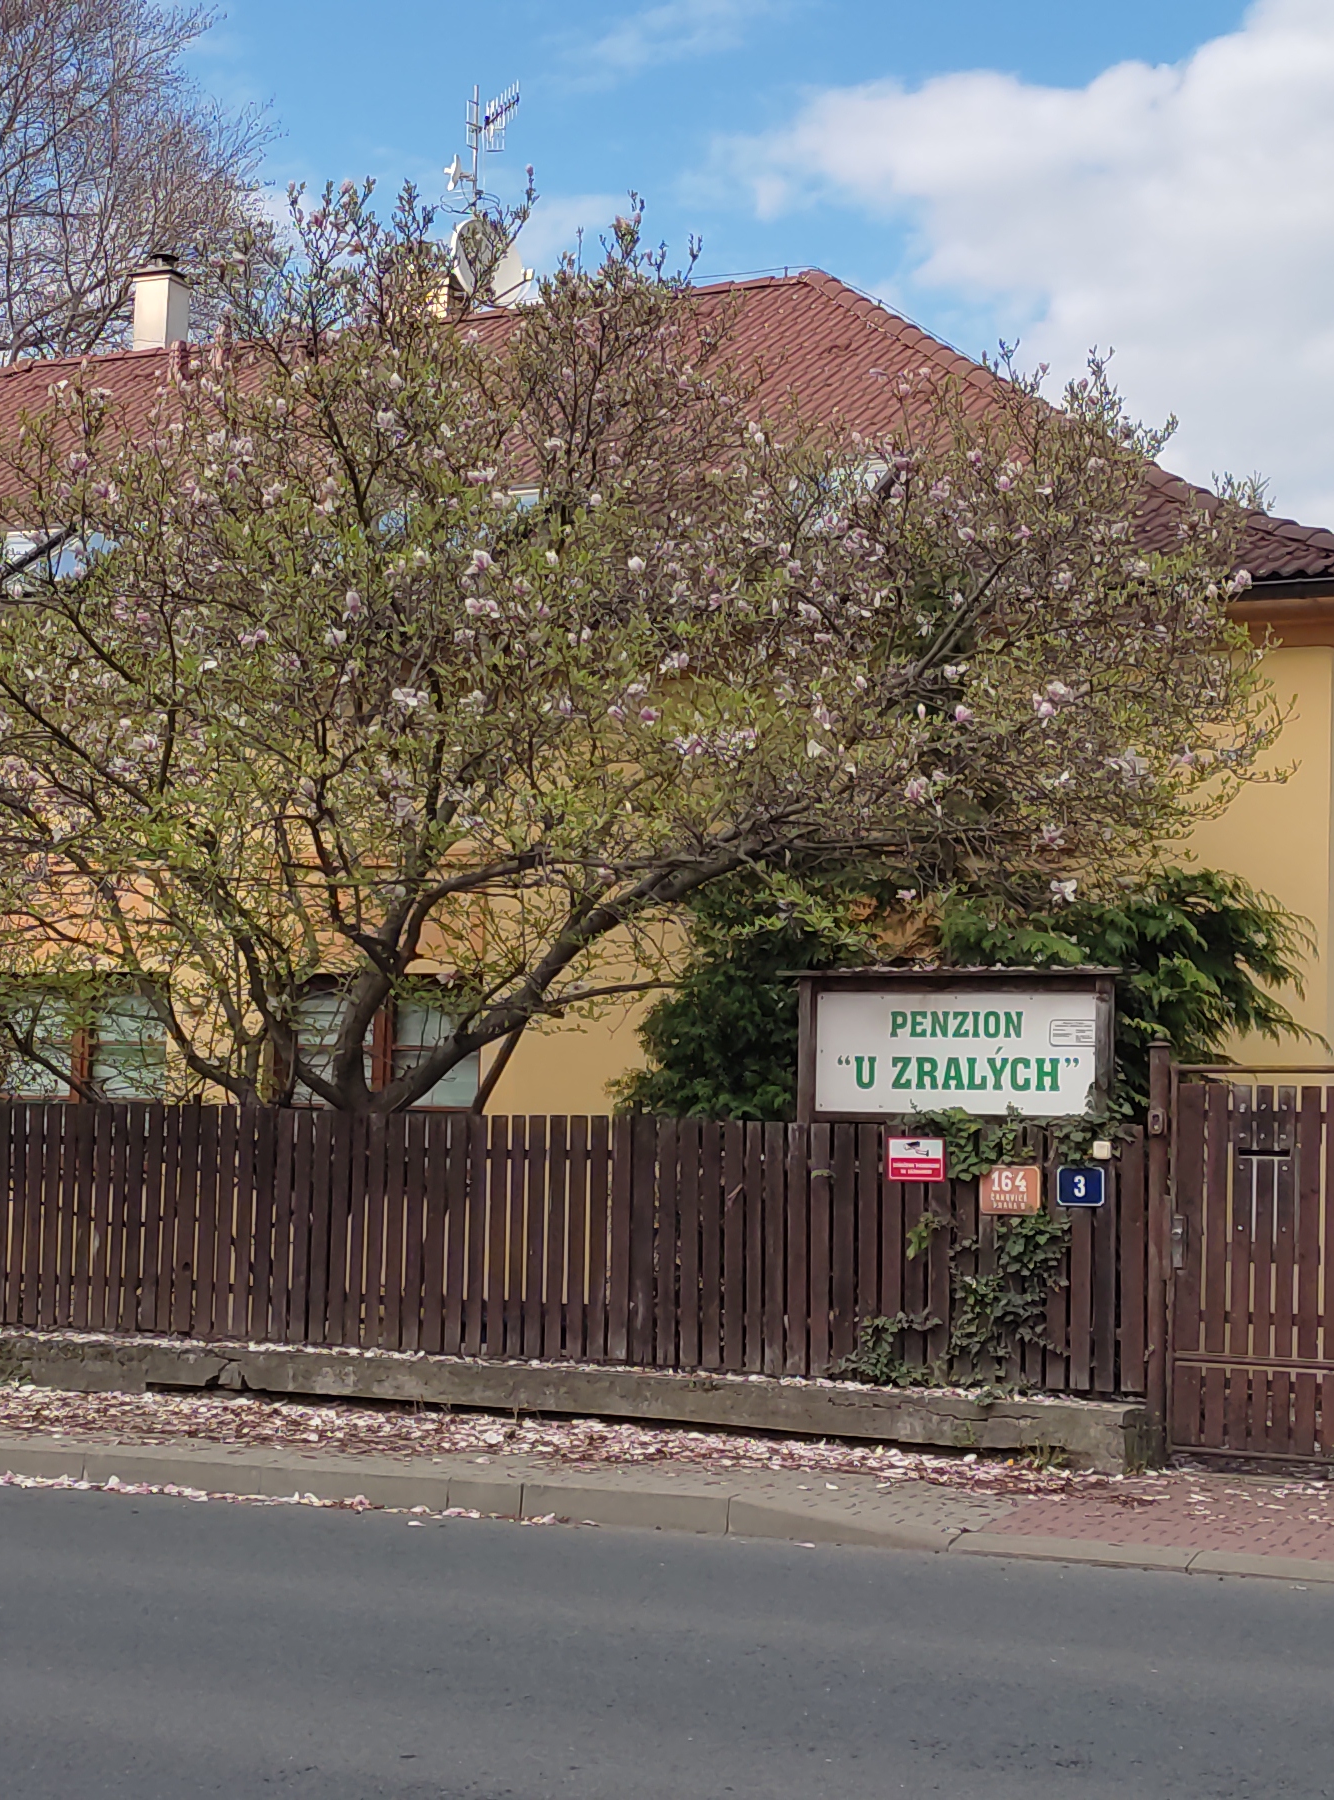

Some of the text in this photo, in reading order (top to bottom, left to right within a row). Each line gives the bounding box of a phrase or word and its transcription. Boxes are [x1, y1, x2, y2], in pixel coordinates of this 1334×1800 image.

[889, 1010, 1024, 1038] PENZION
[991, 1170, 1027, 1192] 164
[1073, 1175, 1086, 1198] 3
